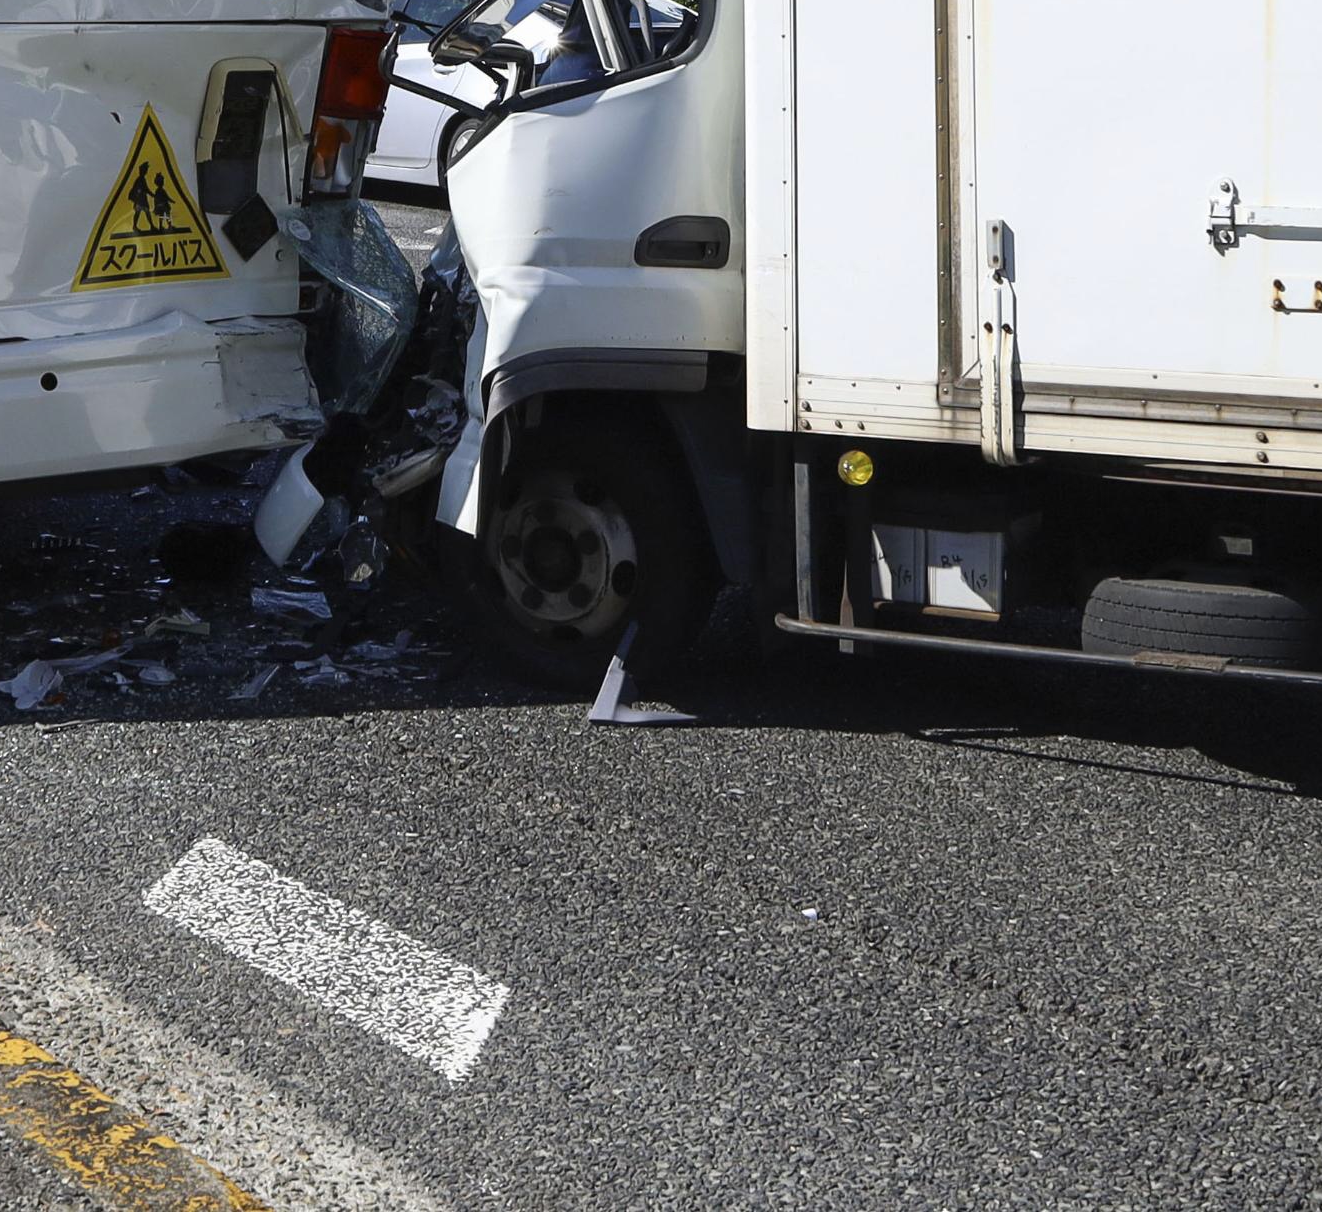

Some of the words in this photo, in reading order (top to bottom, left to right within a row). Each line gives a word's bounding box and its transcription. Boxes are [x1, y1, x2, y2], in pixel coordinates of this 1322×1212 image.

[99, 237, 207, 273] スクールバス
